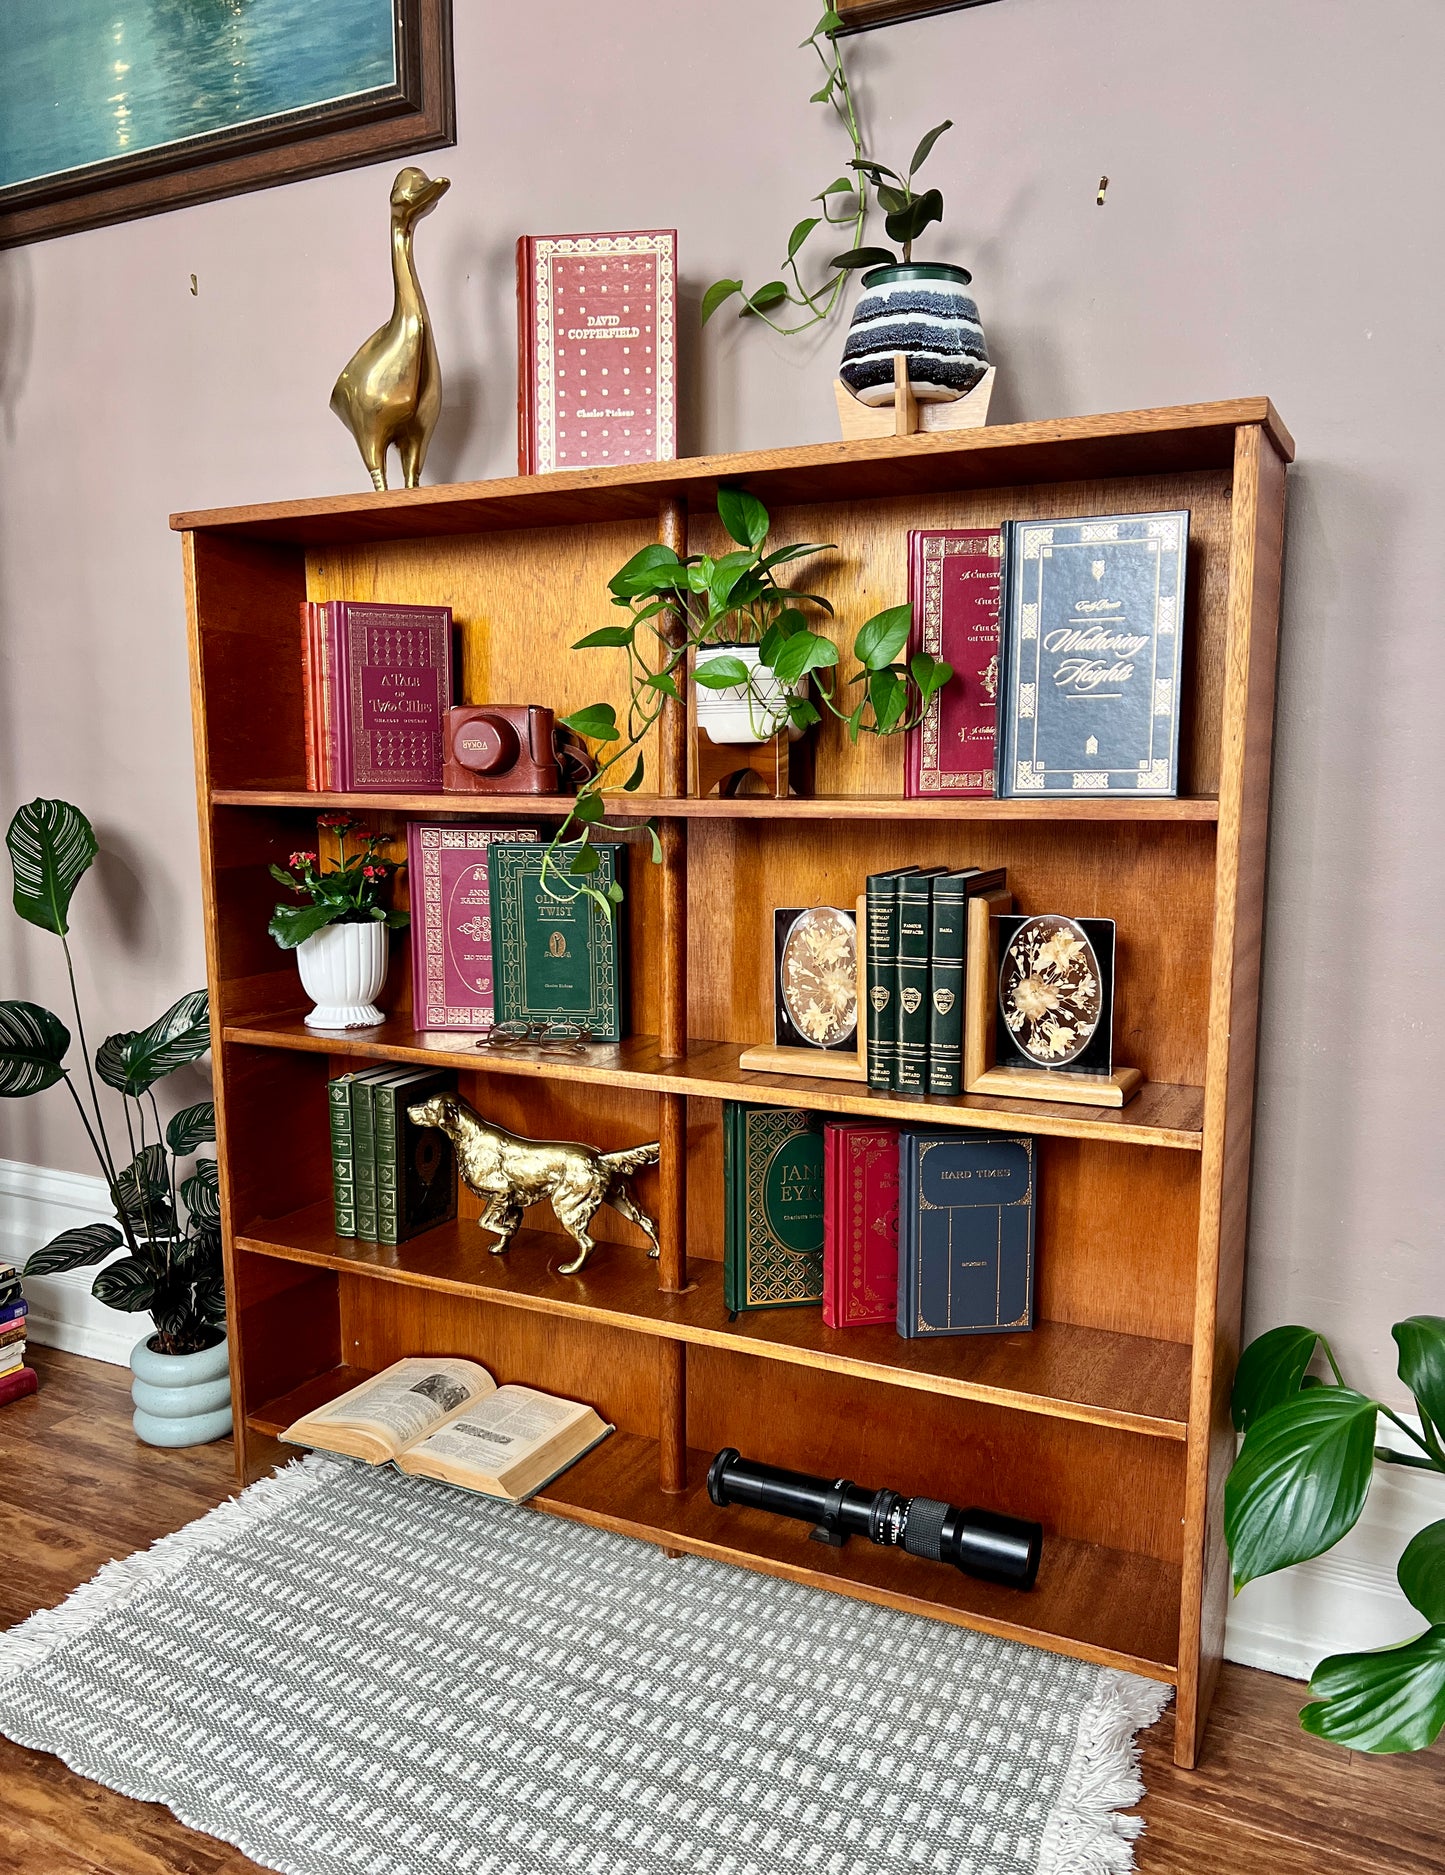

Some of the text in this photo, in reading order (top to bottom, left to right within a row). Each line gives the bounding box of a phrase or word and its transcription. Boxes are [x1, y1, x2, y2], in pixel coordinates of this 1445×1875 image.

[587, 315, 620, 326] DAVID
[568, 327, 640, 339] COPPERFIELD
[1043, 625, 1150, 659] Wuthering
[1053, 657, 1135, 691] Heights
[381, 674, 392, 687] A
[462, 739, 488, 751] VOKAR
[538, 906, 573, 918] TWIST
[941, 1168, 1011, 1180] HARD TIMES
